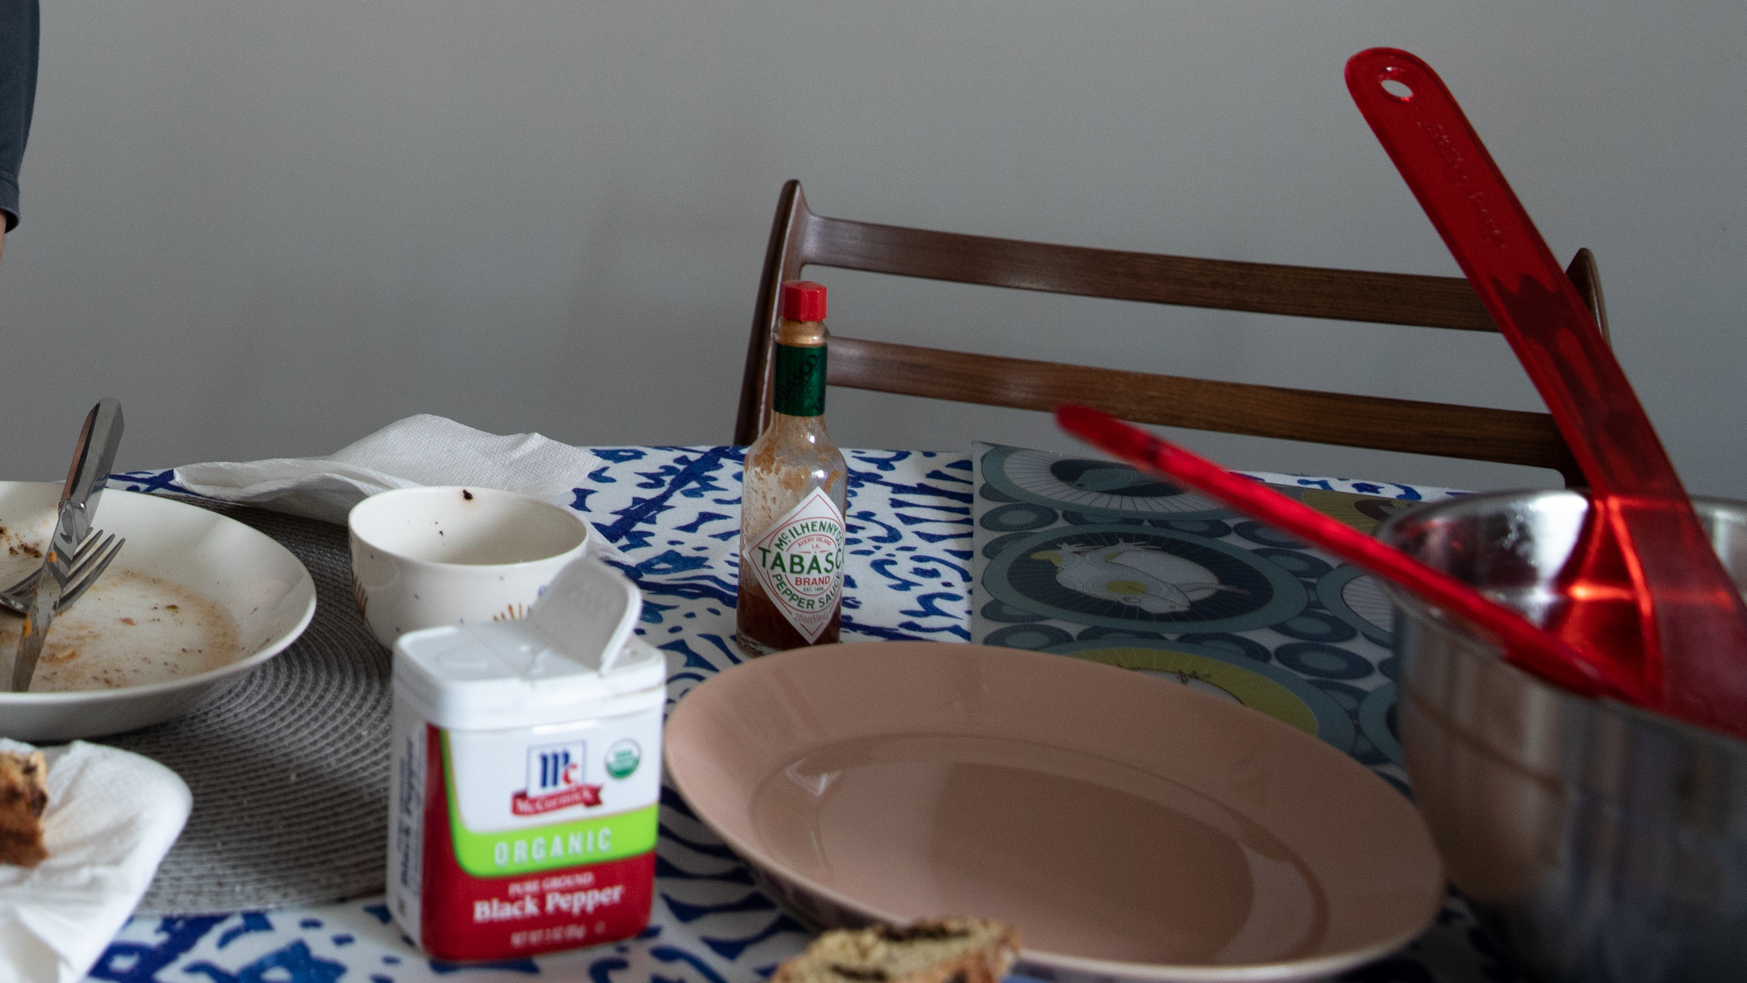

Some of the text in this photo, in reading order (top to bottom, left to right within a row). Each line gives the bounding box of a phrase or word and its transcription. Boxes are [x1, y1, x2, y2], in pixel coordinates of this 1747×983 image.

[757, 546, 844, 575] TABASC
[771, 573, 816, 610] PEPPER
[795, 575, 831, 586] BRAND
[493, 827, 612, 867] ORGANIC
[508, 871, 595, 897] PURE GROUND
[473, 884, 625, 924] Black Pepper
